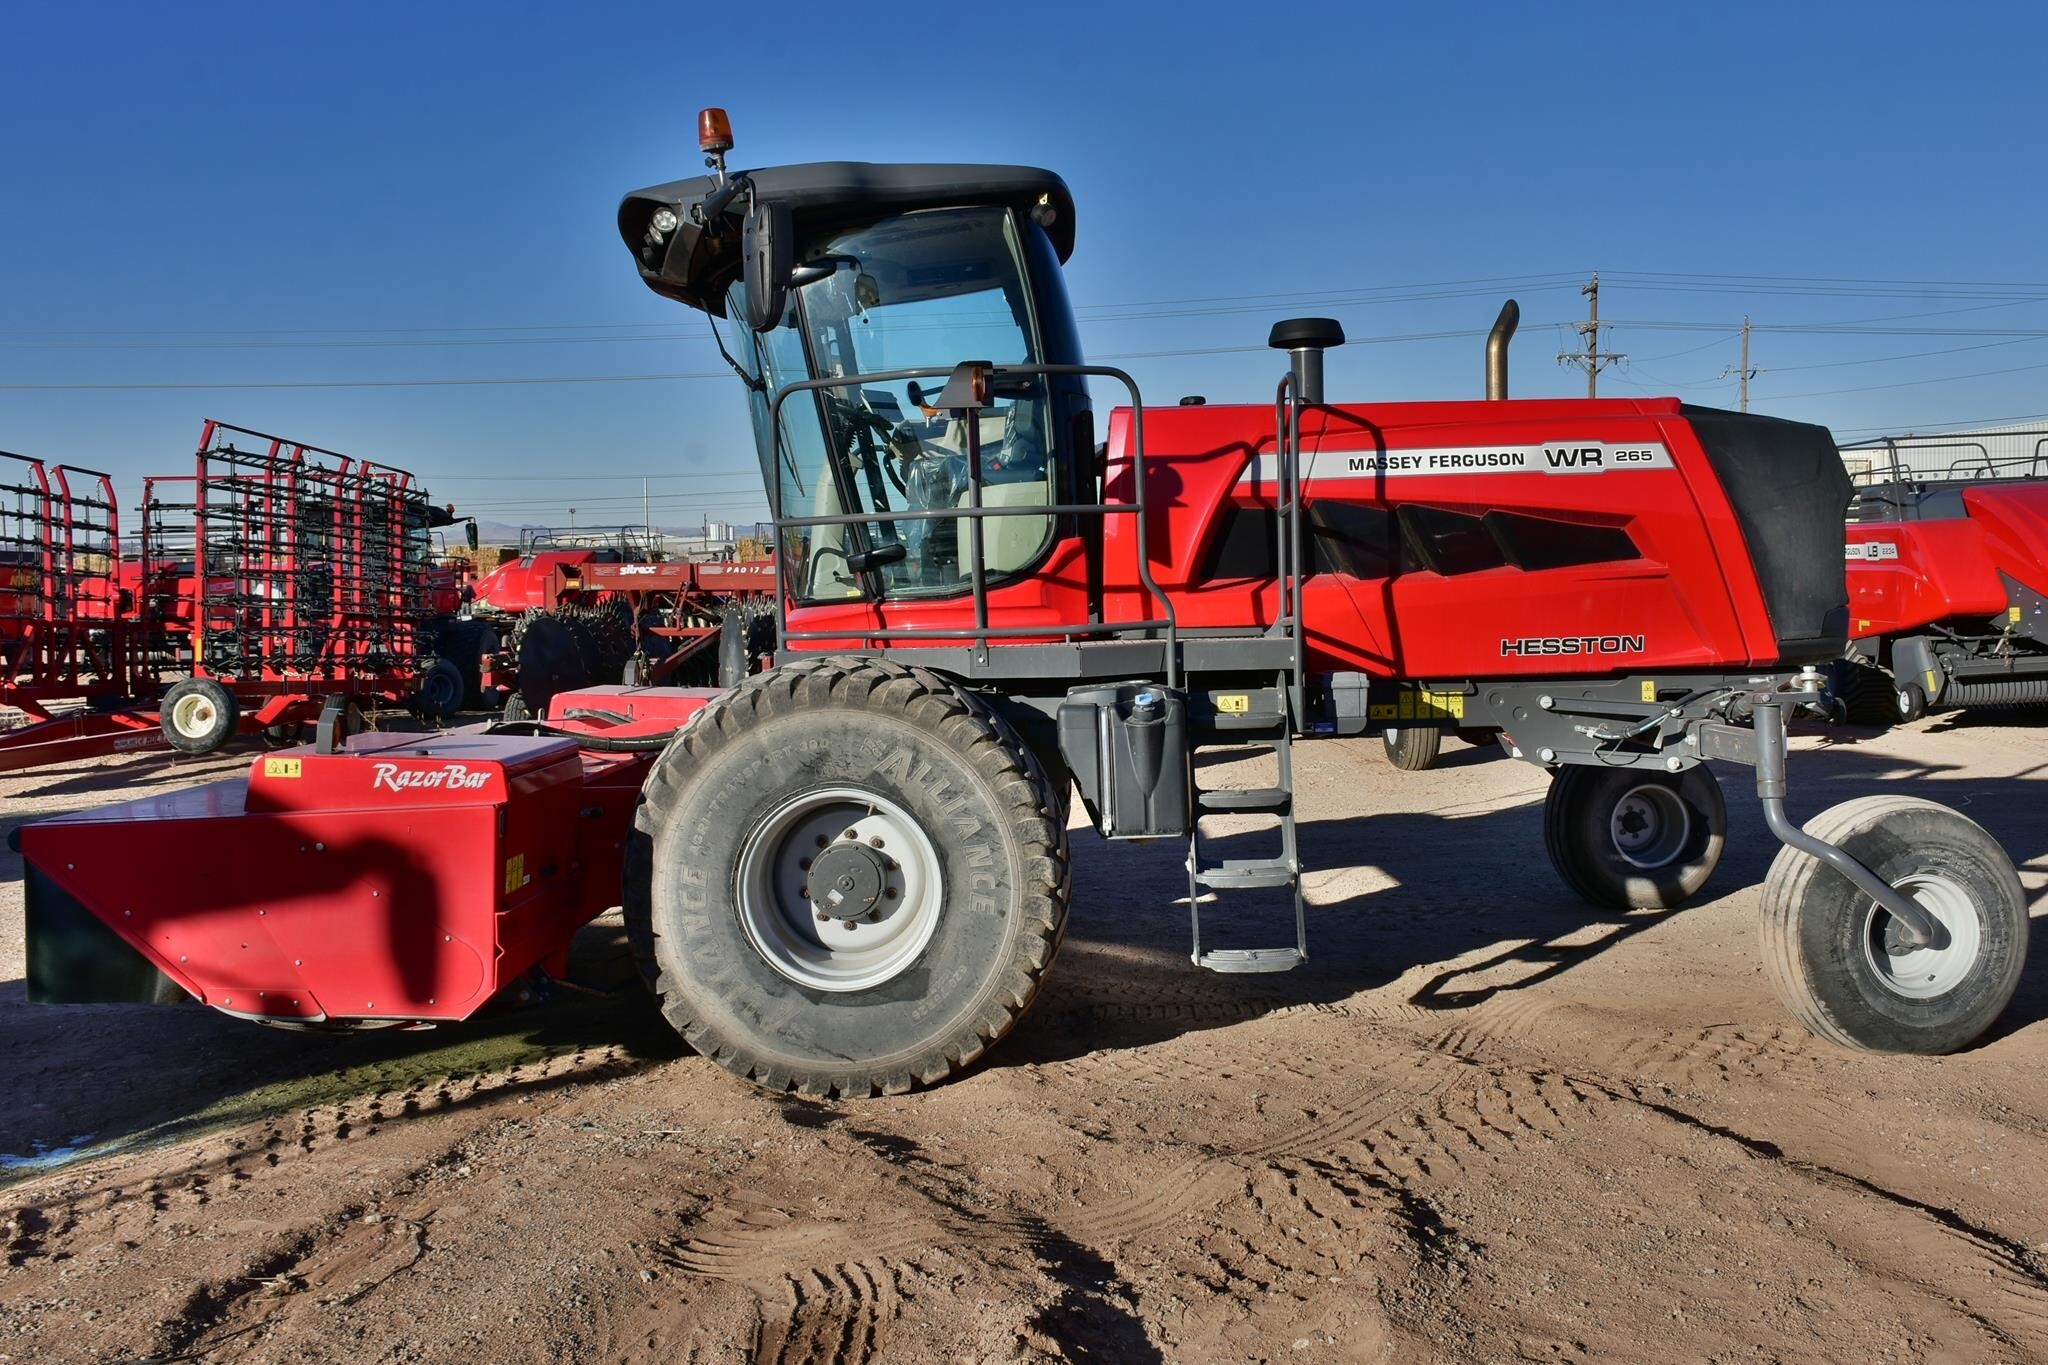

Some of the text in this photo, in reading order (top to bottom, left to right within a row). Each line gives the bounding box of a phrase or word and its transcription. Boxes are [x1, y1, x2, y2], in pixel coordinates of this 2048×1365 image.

[1349, 448, 1653, 471] MASSEY FERGUSON WR 265
[1867, 545, 1878, 557] LB
[1501, 635, 1645, 656] HESSTON
[372, 763, 492, 792] RazorBar
[873, 747, 996, 915] ALLIANCE
